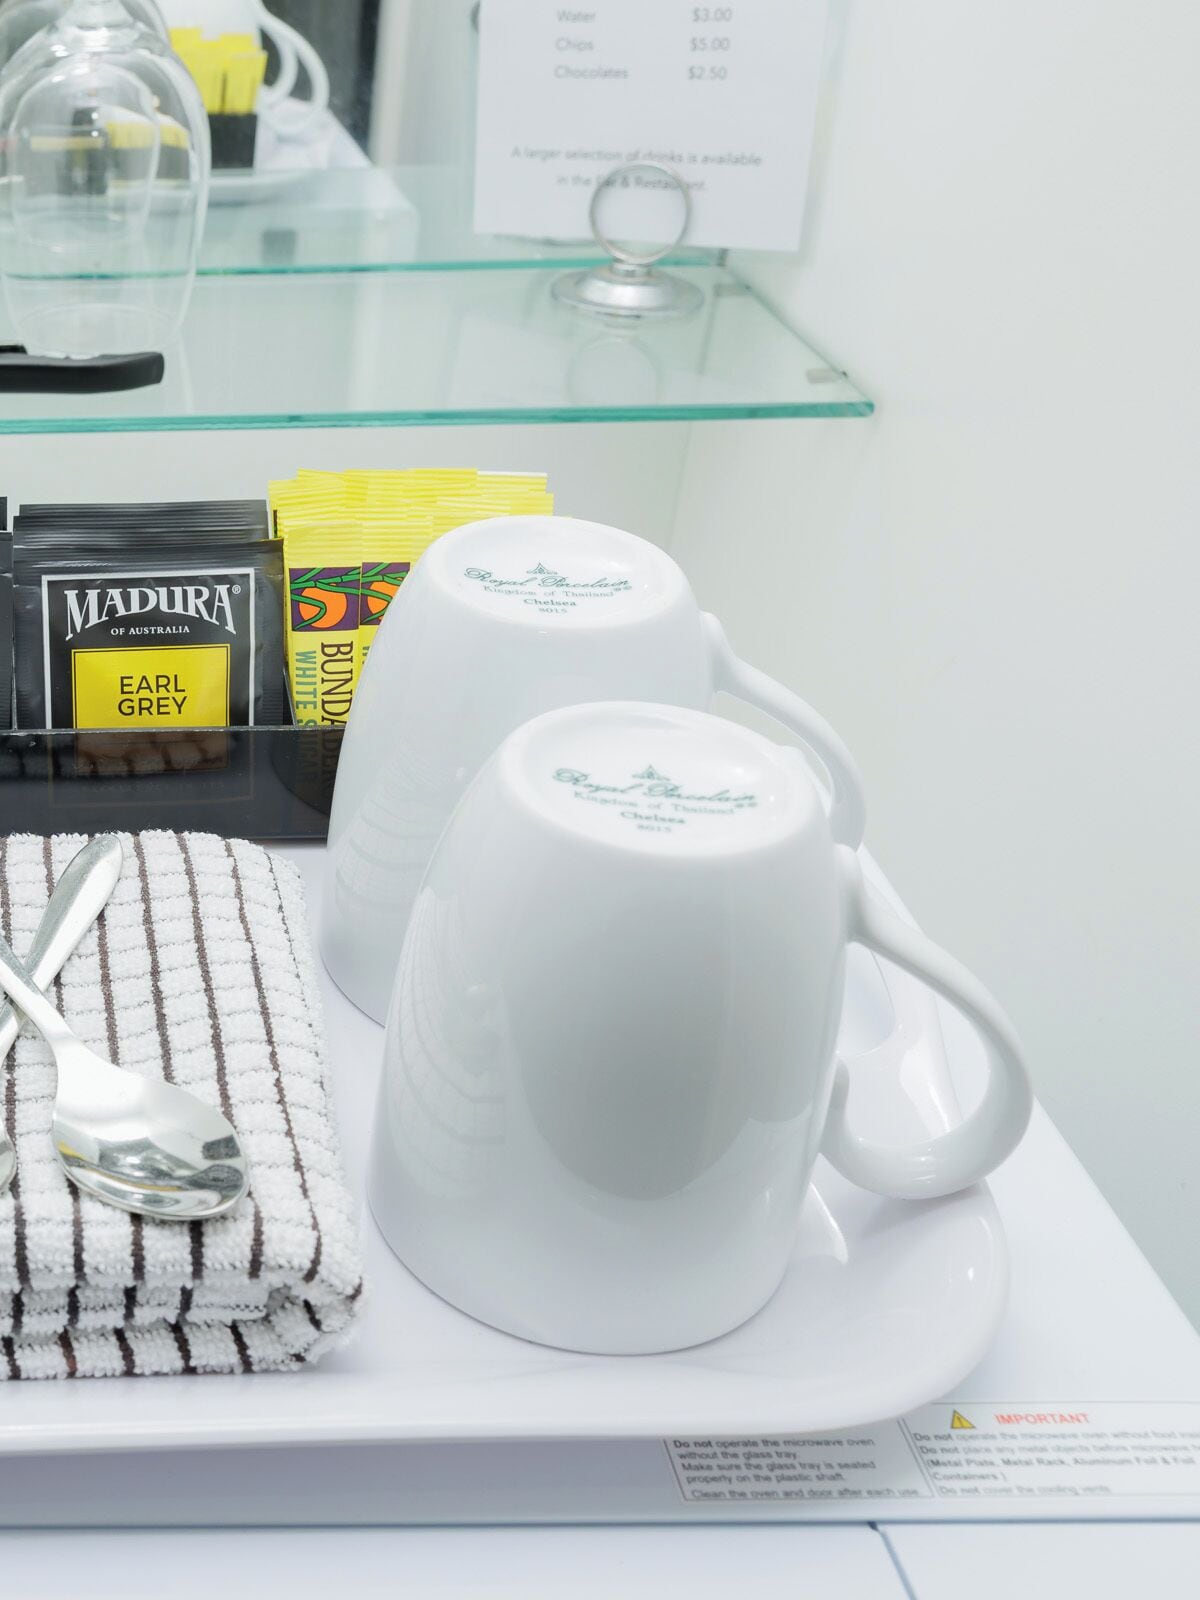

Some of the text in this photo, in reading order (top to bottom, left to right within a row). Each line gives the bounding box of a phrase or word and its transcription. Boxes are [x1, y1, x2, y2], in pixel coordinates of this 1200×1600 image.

[556, 7, 733, 23] Water $3.00
[555, 37, 731, 53] Chips $5.00
[554, 65, 728, 81] Chocolates $2.50
[565, 147, 624, 161] selection
[701, 151, 762, 166] available
[483, 585, 537, 596] Kingdom
[563, 590, 615, 598] Thailand
[523, 598, 577, 607] Chelsea
[64, 584, 237, 641] MADURA
[111, 625, 190, 636] OF AUSTRALIA
[119, 674, 186, 695] EARL
[295, 650, 318, 710] WHITE
[118, 696, 187, 716] GREY
[620, 811, 686, 824] Chelsea
[994, 1412, 1090, 1425] IMPORTANT
[673, 1440, 690, 1449] Do
[693, 1440, 712, 1448] not
[715, 1439, 759, 1449] operate
[761, 1439, 780, 1447] the
[783, 1438, 843, 1447] microwave
[913, 1432, 930, 1441] Do
[934, 1433, 952, 1441] not
[956, 1433, 996, 1442] operate
[1020, 1432, 1079, 1440] microwave
[678, 1451, 718, 1459] without
[720, 1451, 739, 1459] the
[742, 1451, 772, 1461] glass
[919, 1445, 937, 1454] Do
[941, 1446, 959, 1454] not
[682, 1463, 713, 1471] Make
[766, 1462, 797, 1472] glass
[798, 1461, 821, 1471] tray
[823, 1461, 834, 1469] is
[837, 1460, 876, 1469] seated
[686, 1474, 732, 1484] properly
[752, 1474, 772, 1482] the
[775, 1473, 813, 1483] plastic
[691, 1490, 726, 1498] Clean
[728, 1489, 747, 1497] the
[750, 1490, 778, 1498] oven
[781, 1489, 804, 1497] and
[808, 1488, 833, 1496] door
[939, 1486, 958, 1495] Do
[960, 1486, 980, 1494] not
